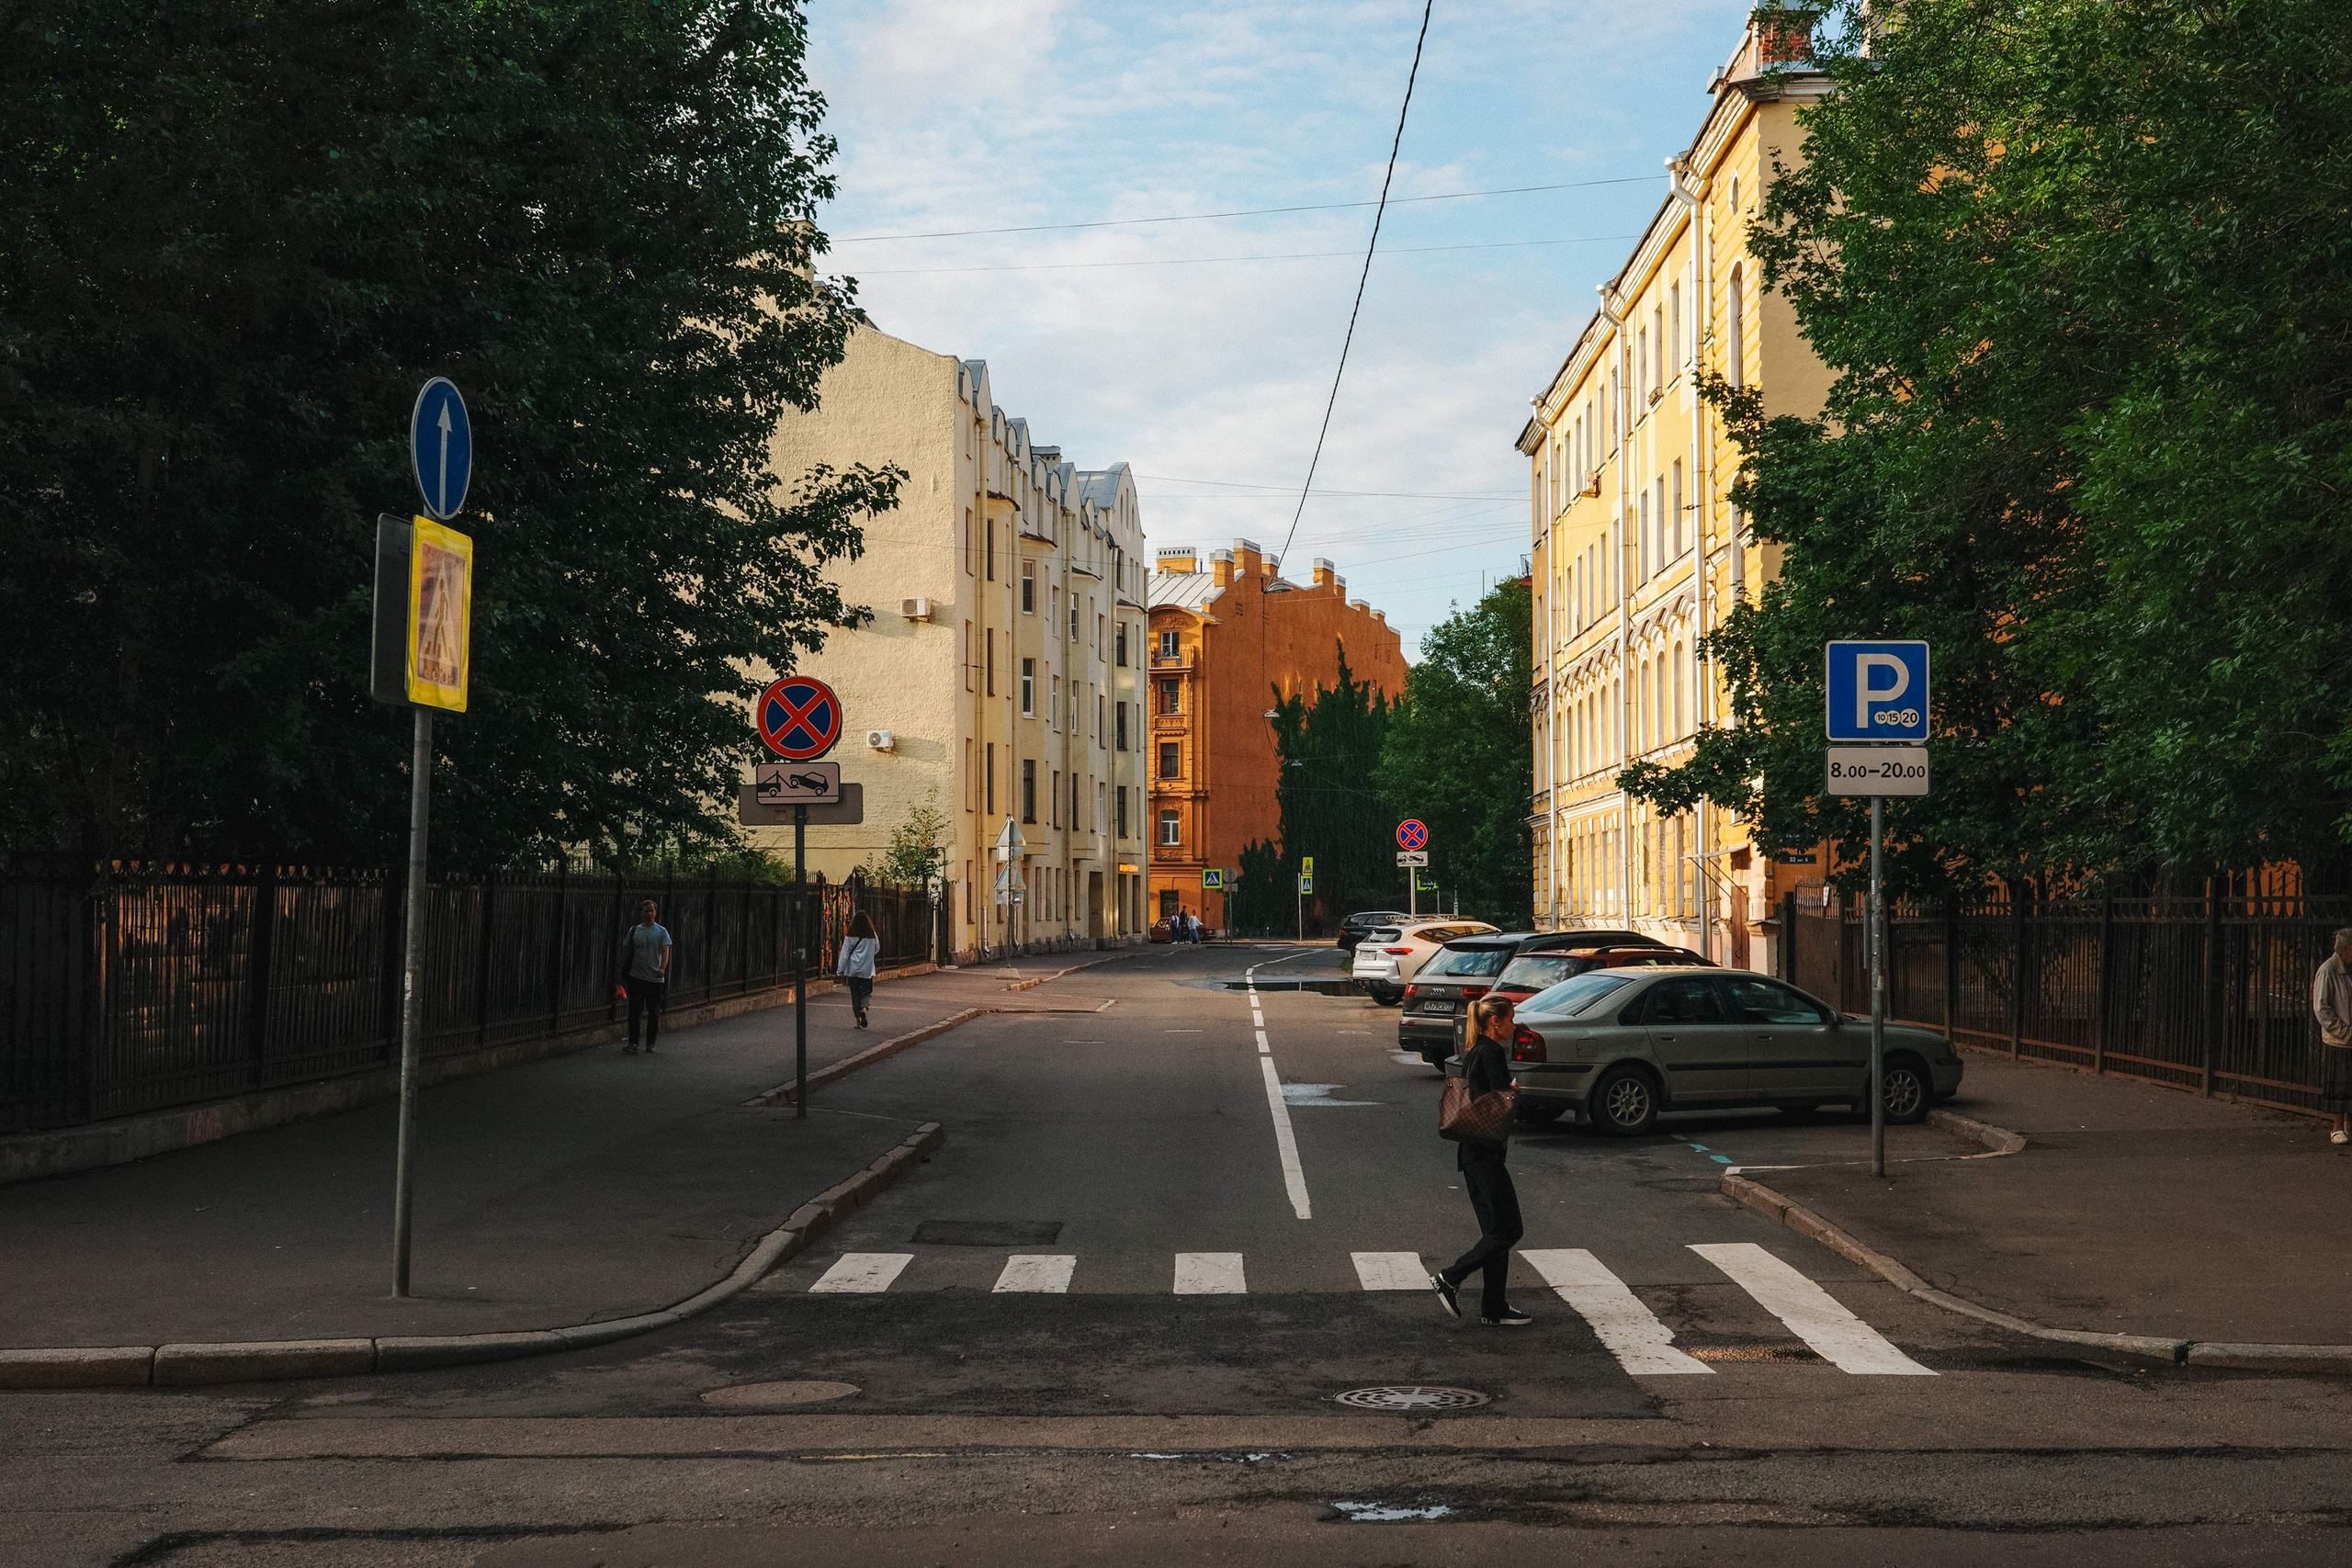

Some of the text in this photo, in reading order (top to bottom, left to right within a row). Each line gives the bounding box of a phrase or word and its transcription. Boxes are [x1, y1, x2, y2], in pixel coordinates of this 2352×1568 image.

[1856, 653, 1910, 728] P
[1888, 713, 1898, 722] 15
[1902, 712, 1917, 724] 20
